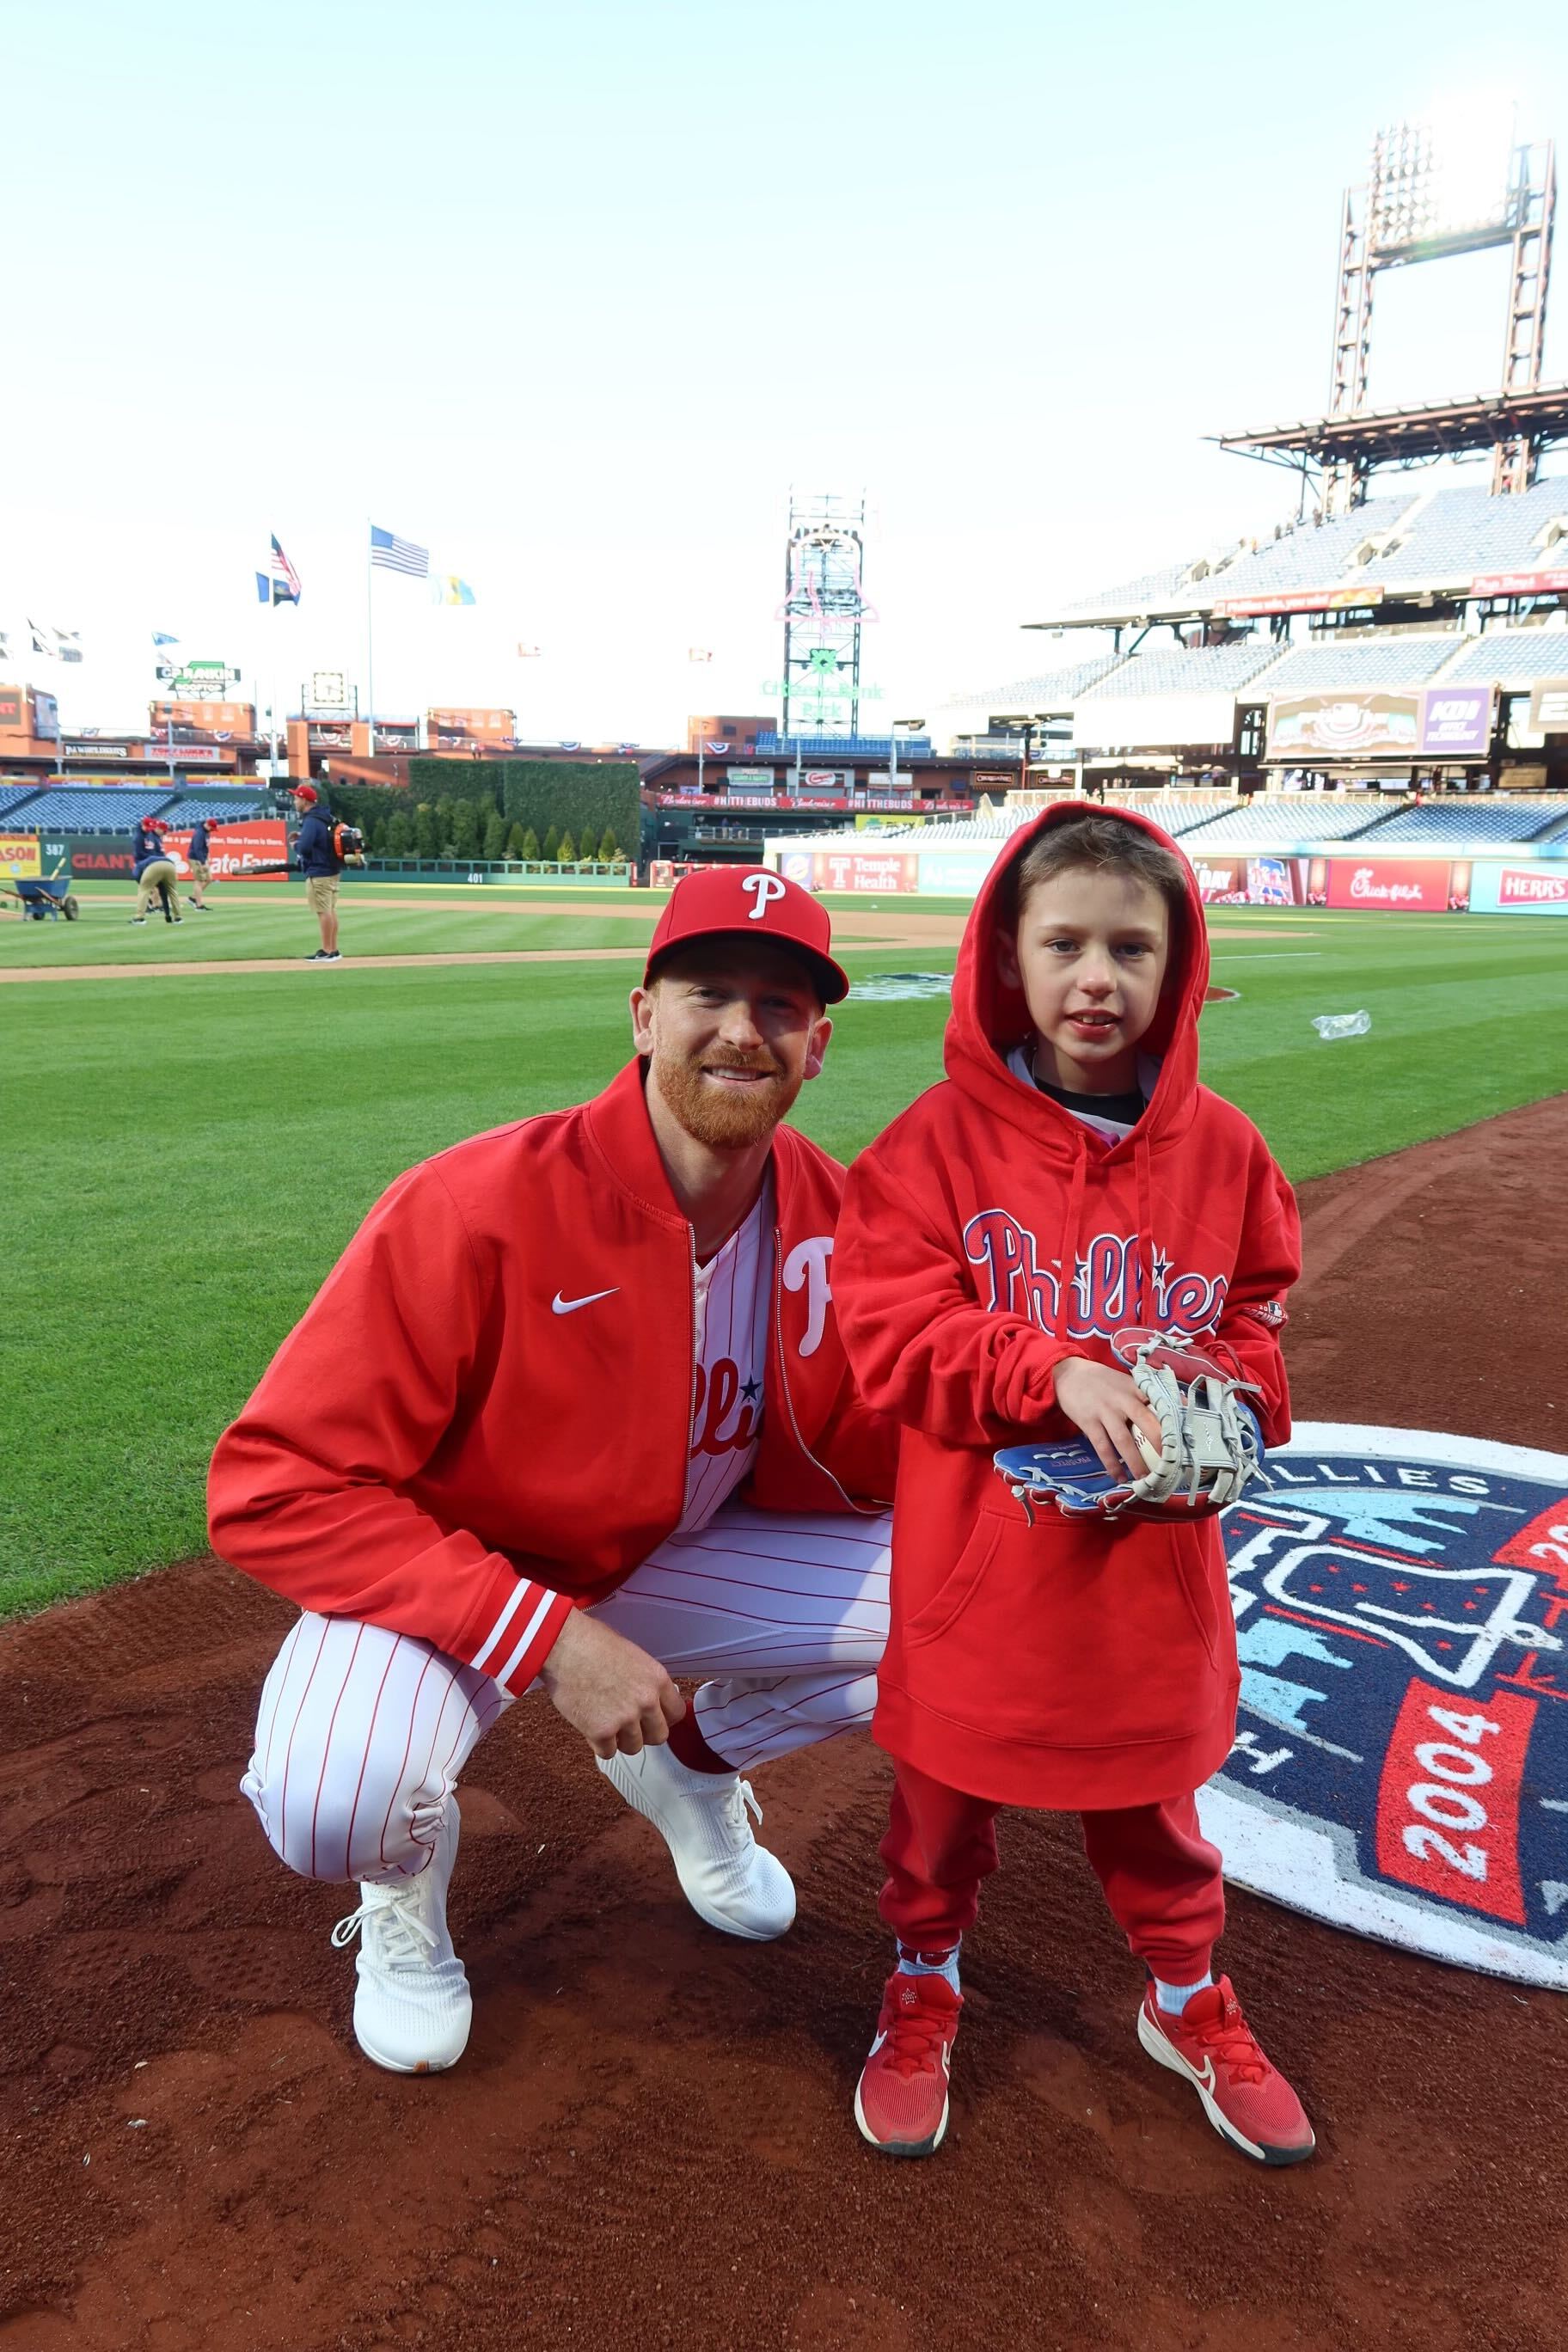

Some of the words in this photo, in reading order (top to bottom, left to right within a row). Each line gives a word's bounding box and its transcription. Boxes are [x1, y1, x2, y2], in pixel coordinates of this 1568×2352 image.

[45, 844, 64, 855] 387
[71, 852, 135, 869] GIANT
[854, 858, 902, 877] Temple
[468, 873, 483, 884] 401
[854, 875, 897, 890] Health
[742, 873, 786, 920] P
[1505, 877, 1566, 899] HERR'S
[1402, 1705, 1501, 1883] 2004
